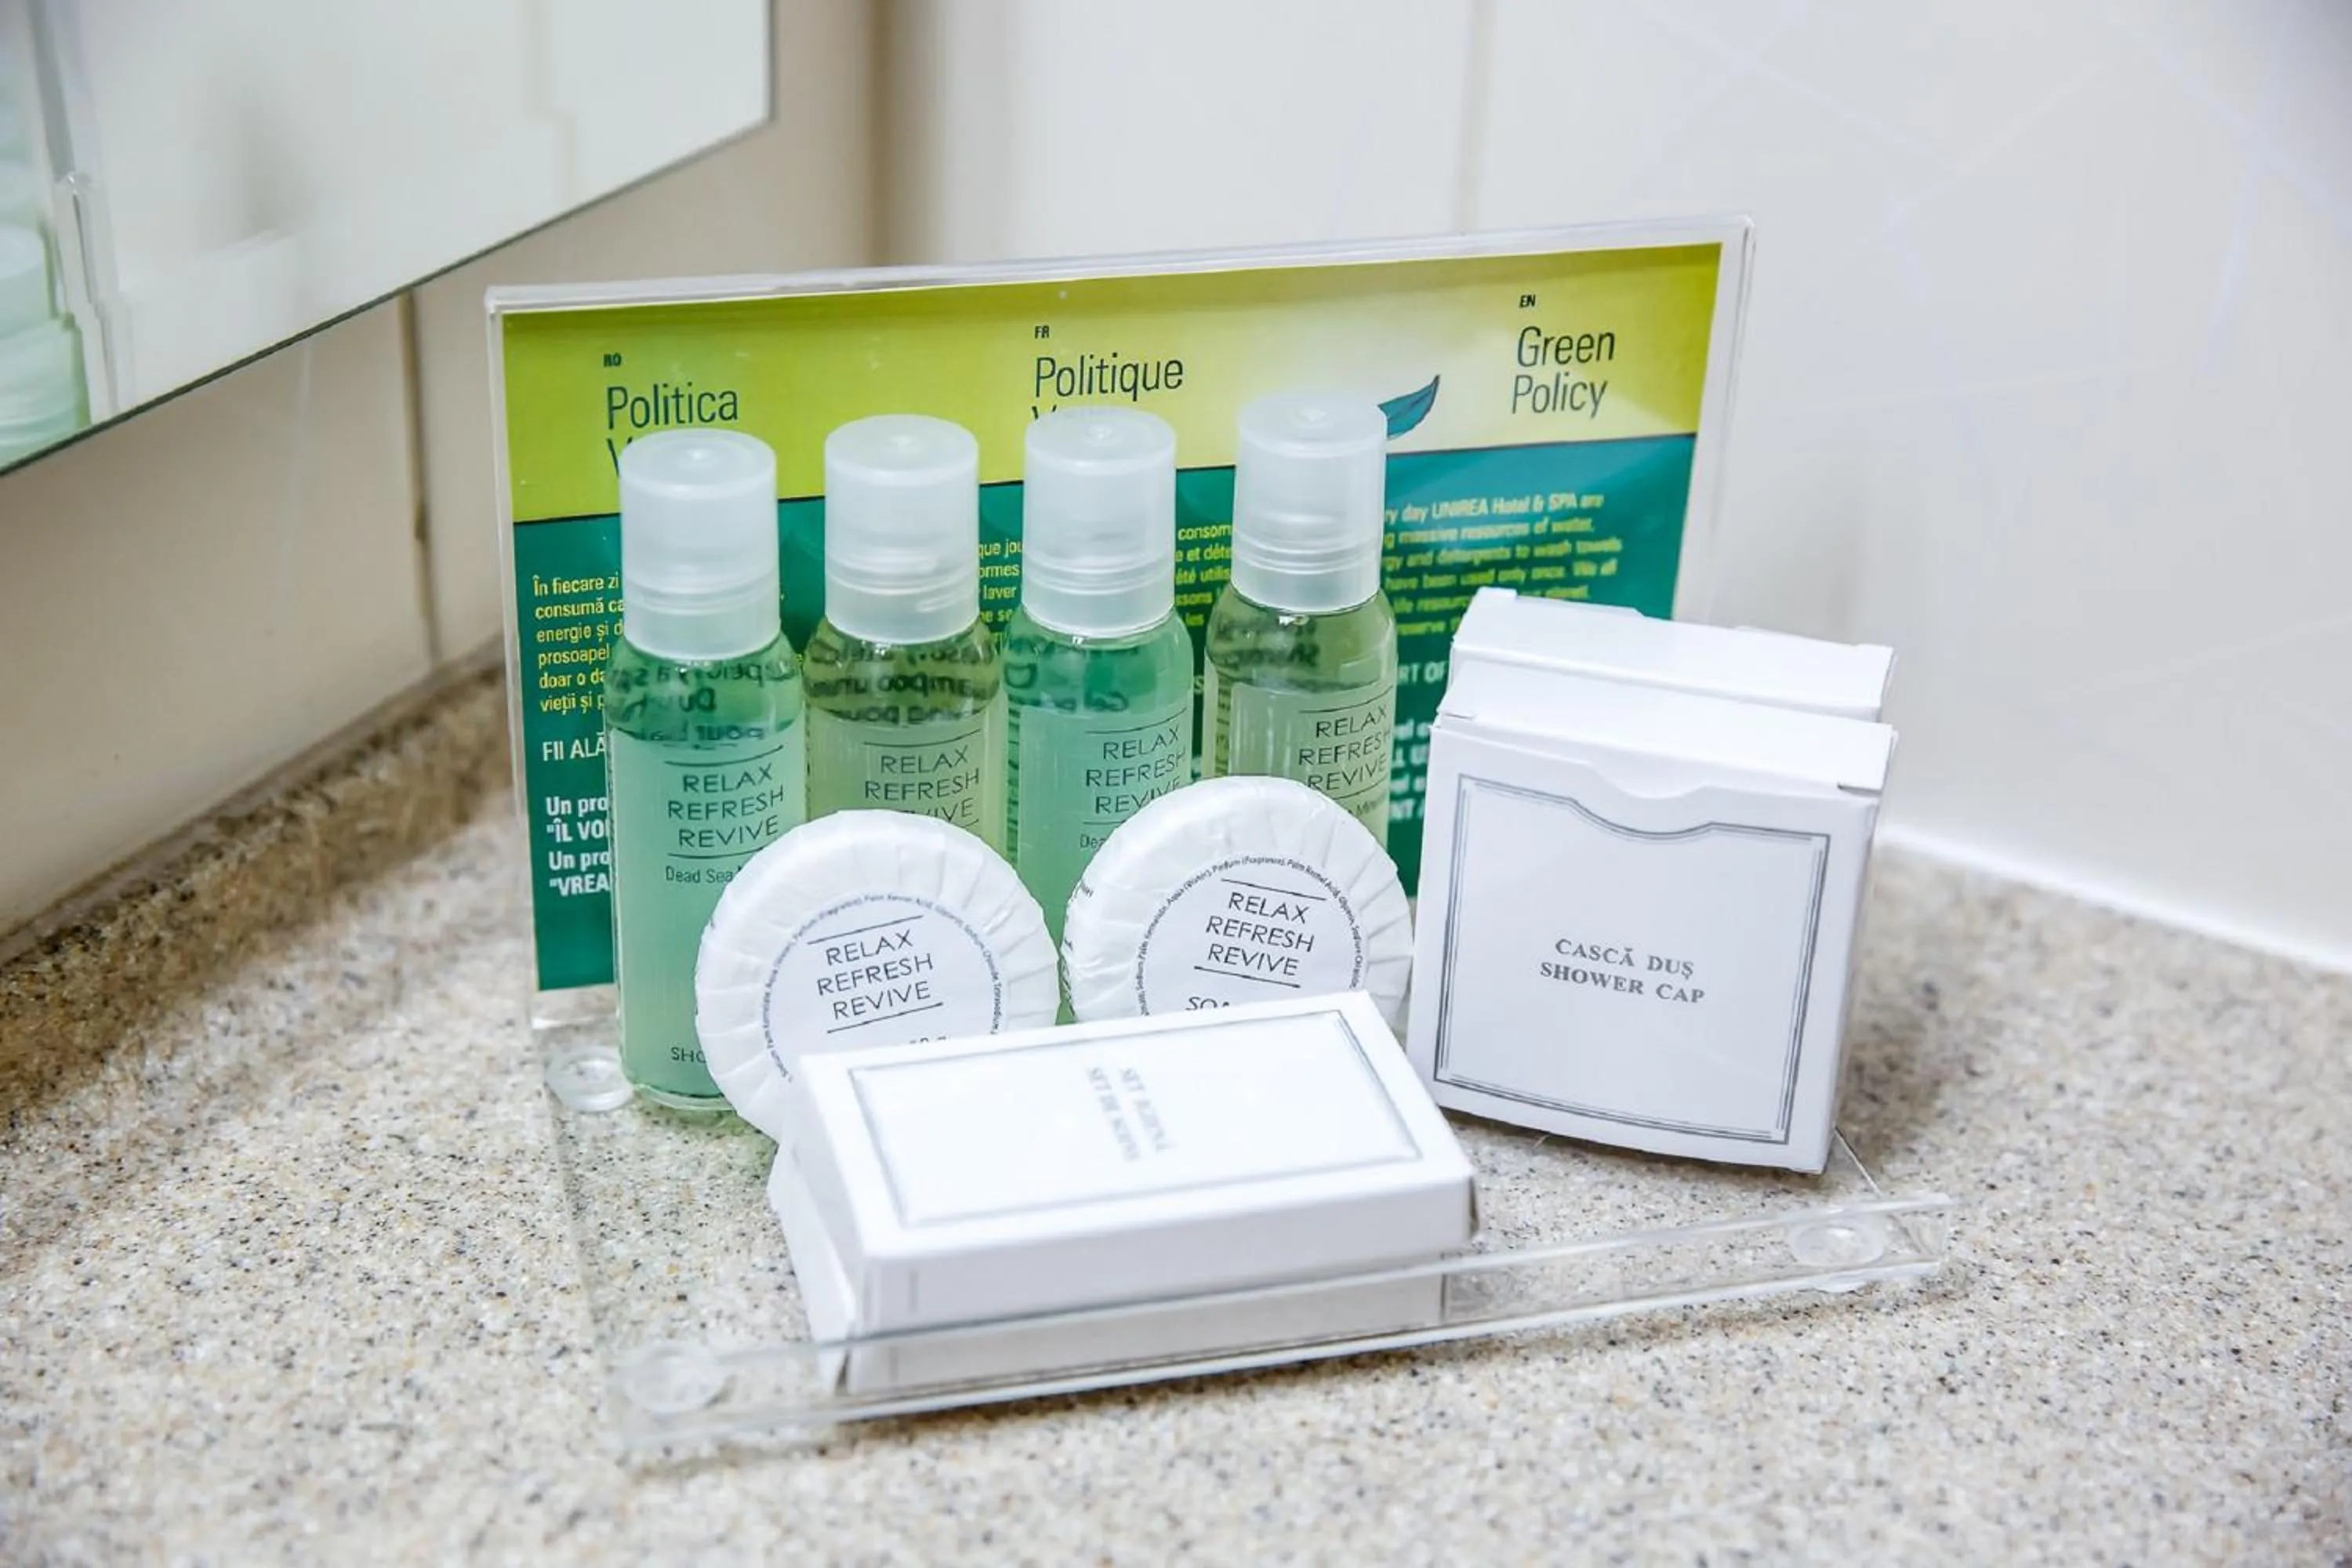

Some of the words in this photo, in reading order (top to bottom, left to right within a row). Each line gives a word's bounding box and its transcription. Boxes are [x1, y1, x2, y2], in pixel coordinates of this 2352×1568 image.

[1519, 294, 1537, 308] EN
[1034, 325, 1050, 339] FR
[1517, 325, 1616, 367] Green
[603, 353, 622, 367] RO
[1033, 351, 1184, 401] Politique
[606, 381, 739, 430] Politica
[1512, 371, 1609, 419] Policy
[533, 575, 548, 597] În
[552, 576, 604, 595] fiecare
[608, 571, 619, 589] zi
[983, 584, 1018, 600] laver
[535, 597, 605, 619] consumă
[535, 621, 592, 644] energie
[538, 643, 610, 670] prosoapel
[539, 671, 572, 689] doar
[576, 672, 586, 686] o
[1316, 705, 1388, 739] RELAX
[543, 741, 564, 762] FII
[570, 731, 606, 760] ALĂ
[1103, 724, 1180, 760] RELAX
[1298, 728, 1391, 766] REFRESH
[880, 745, 970, 775] RELAX
[1085, 744, 1187, 788] REFRESH
[1307, 752, 1388, 792] REVIVE
[682, 762, 773, 793] RELAX
[864, 768, 980, 801] REFRESH
[546, 796, 572, 817] Un
[577, 795, 608, 818] pro
[667, 784, 784, 821] REFRESH
[677, 815, 779, 848] REVIVE
[549, 850, 575, 871] Un
[579, 850, 609, 873] pro
[666, 865, 701, 884] Dead
[706, 868, 735, 884] Sea
[1229, 891, 1310, 924] RELAX
[826, 928, 913, 966] RELAX
[1205, 915, 1315, 953] REFRESH
[1208, 942, 1299, 977] REVIVE
[1555, 938, 1635, 967] CASCĂ
[816, 953, 934, 996] REFRESH
[1540, 962, 1645, 996] SHOWER
[1655, 982, 1705, 1004] CAP
[833, 980, 931, 1020] REVIVE
[1185, 996, 1229, 1011] SO
